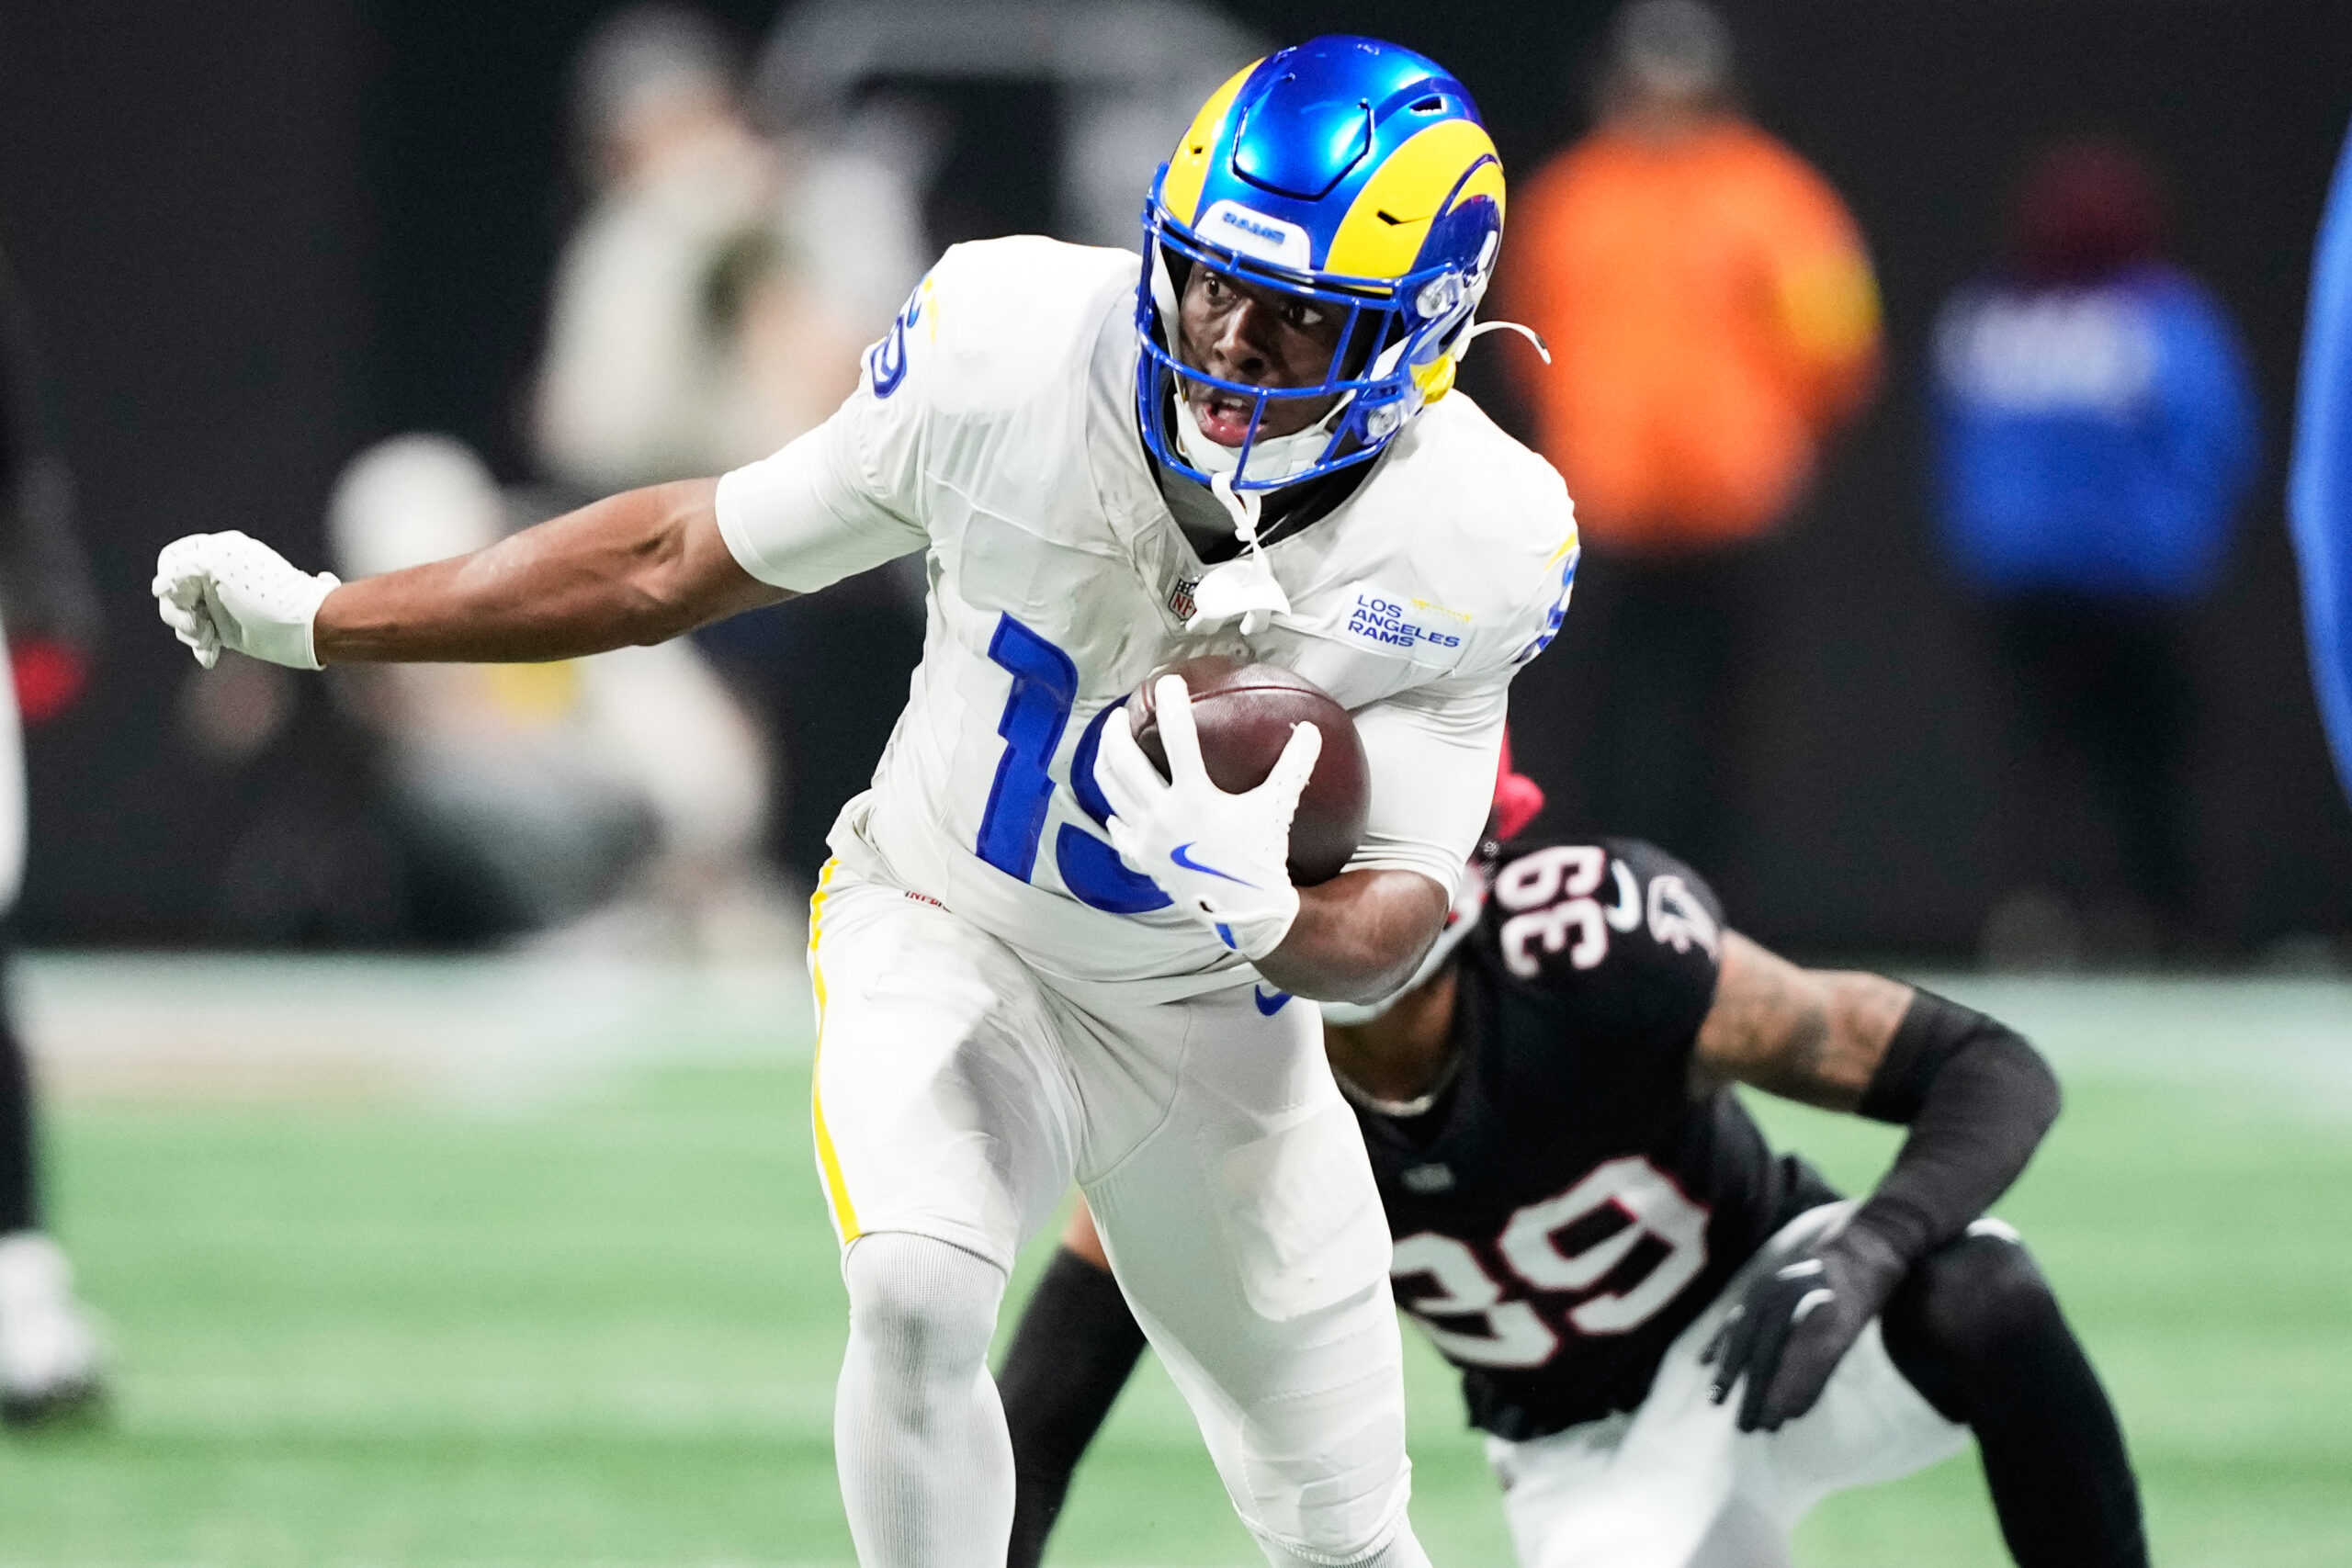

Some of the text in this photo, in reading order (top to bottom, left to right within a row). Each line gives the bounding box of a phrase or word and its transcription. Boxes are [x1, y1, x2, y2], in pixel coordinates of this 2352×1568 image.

[1358, 594, 1402, 618] LOS
[1348, 620, 1415, 648] RAMS
[1352, 609, 1461, 648] ANGELES
[1494, 845, 1608, 979] 39
